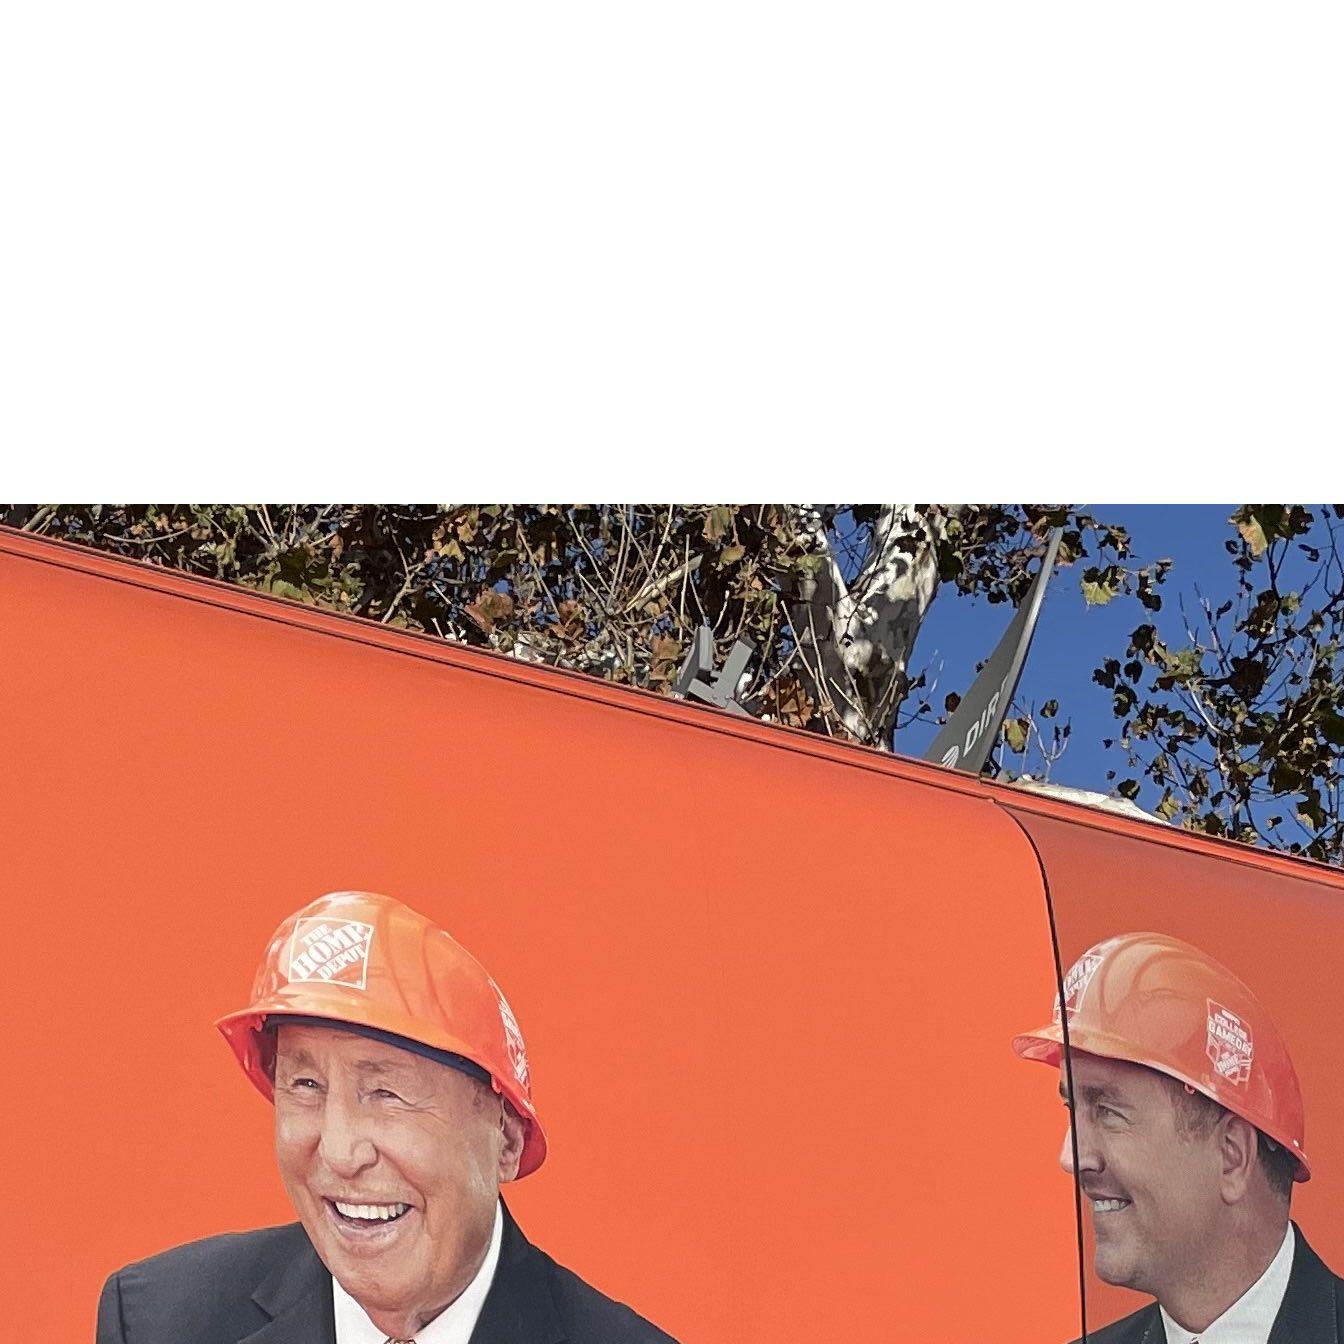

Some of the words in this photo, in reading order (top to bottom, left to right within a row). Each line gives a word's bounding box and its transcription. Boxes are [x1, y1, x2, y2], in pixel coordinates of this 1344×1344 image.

[291, 924, 369, 980] HOME
[300, 923, 333, 947] THE
[316, 942, 366, 980] DEPOT
